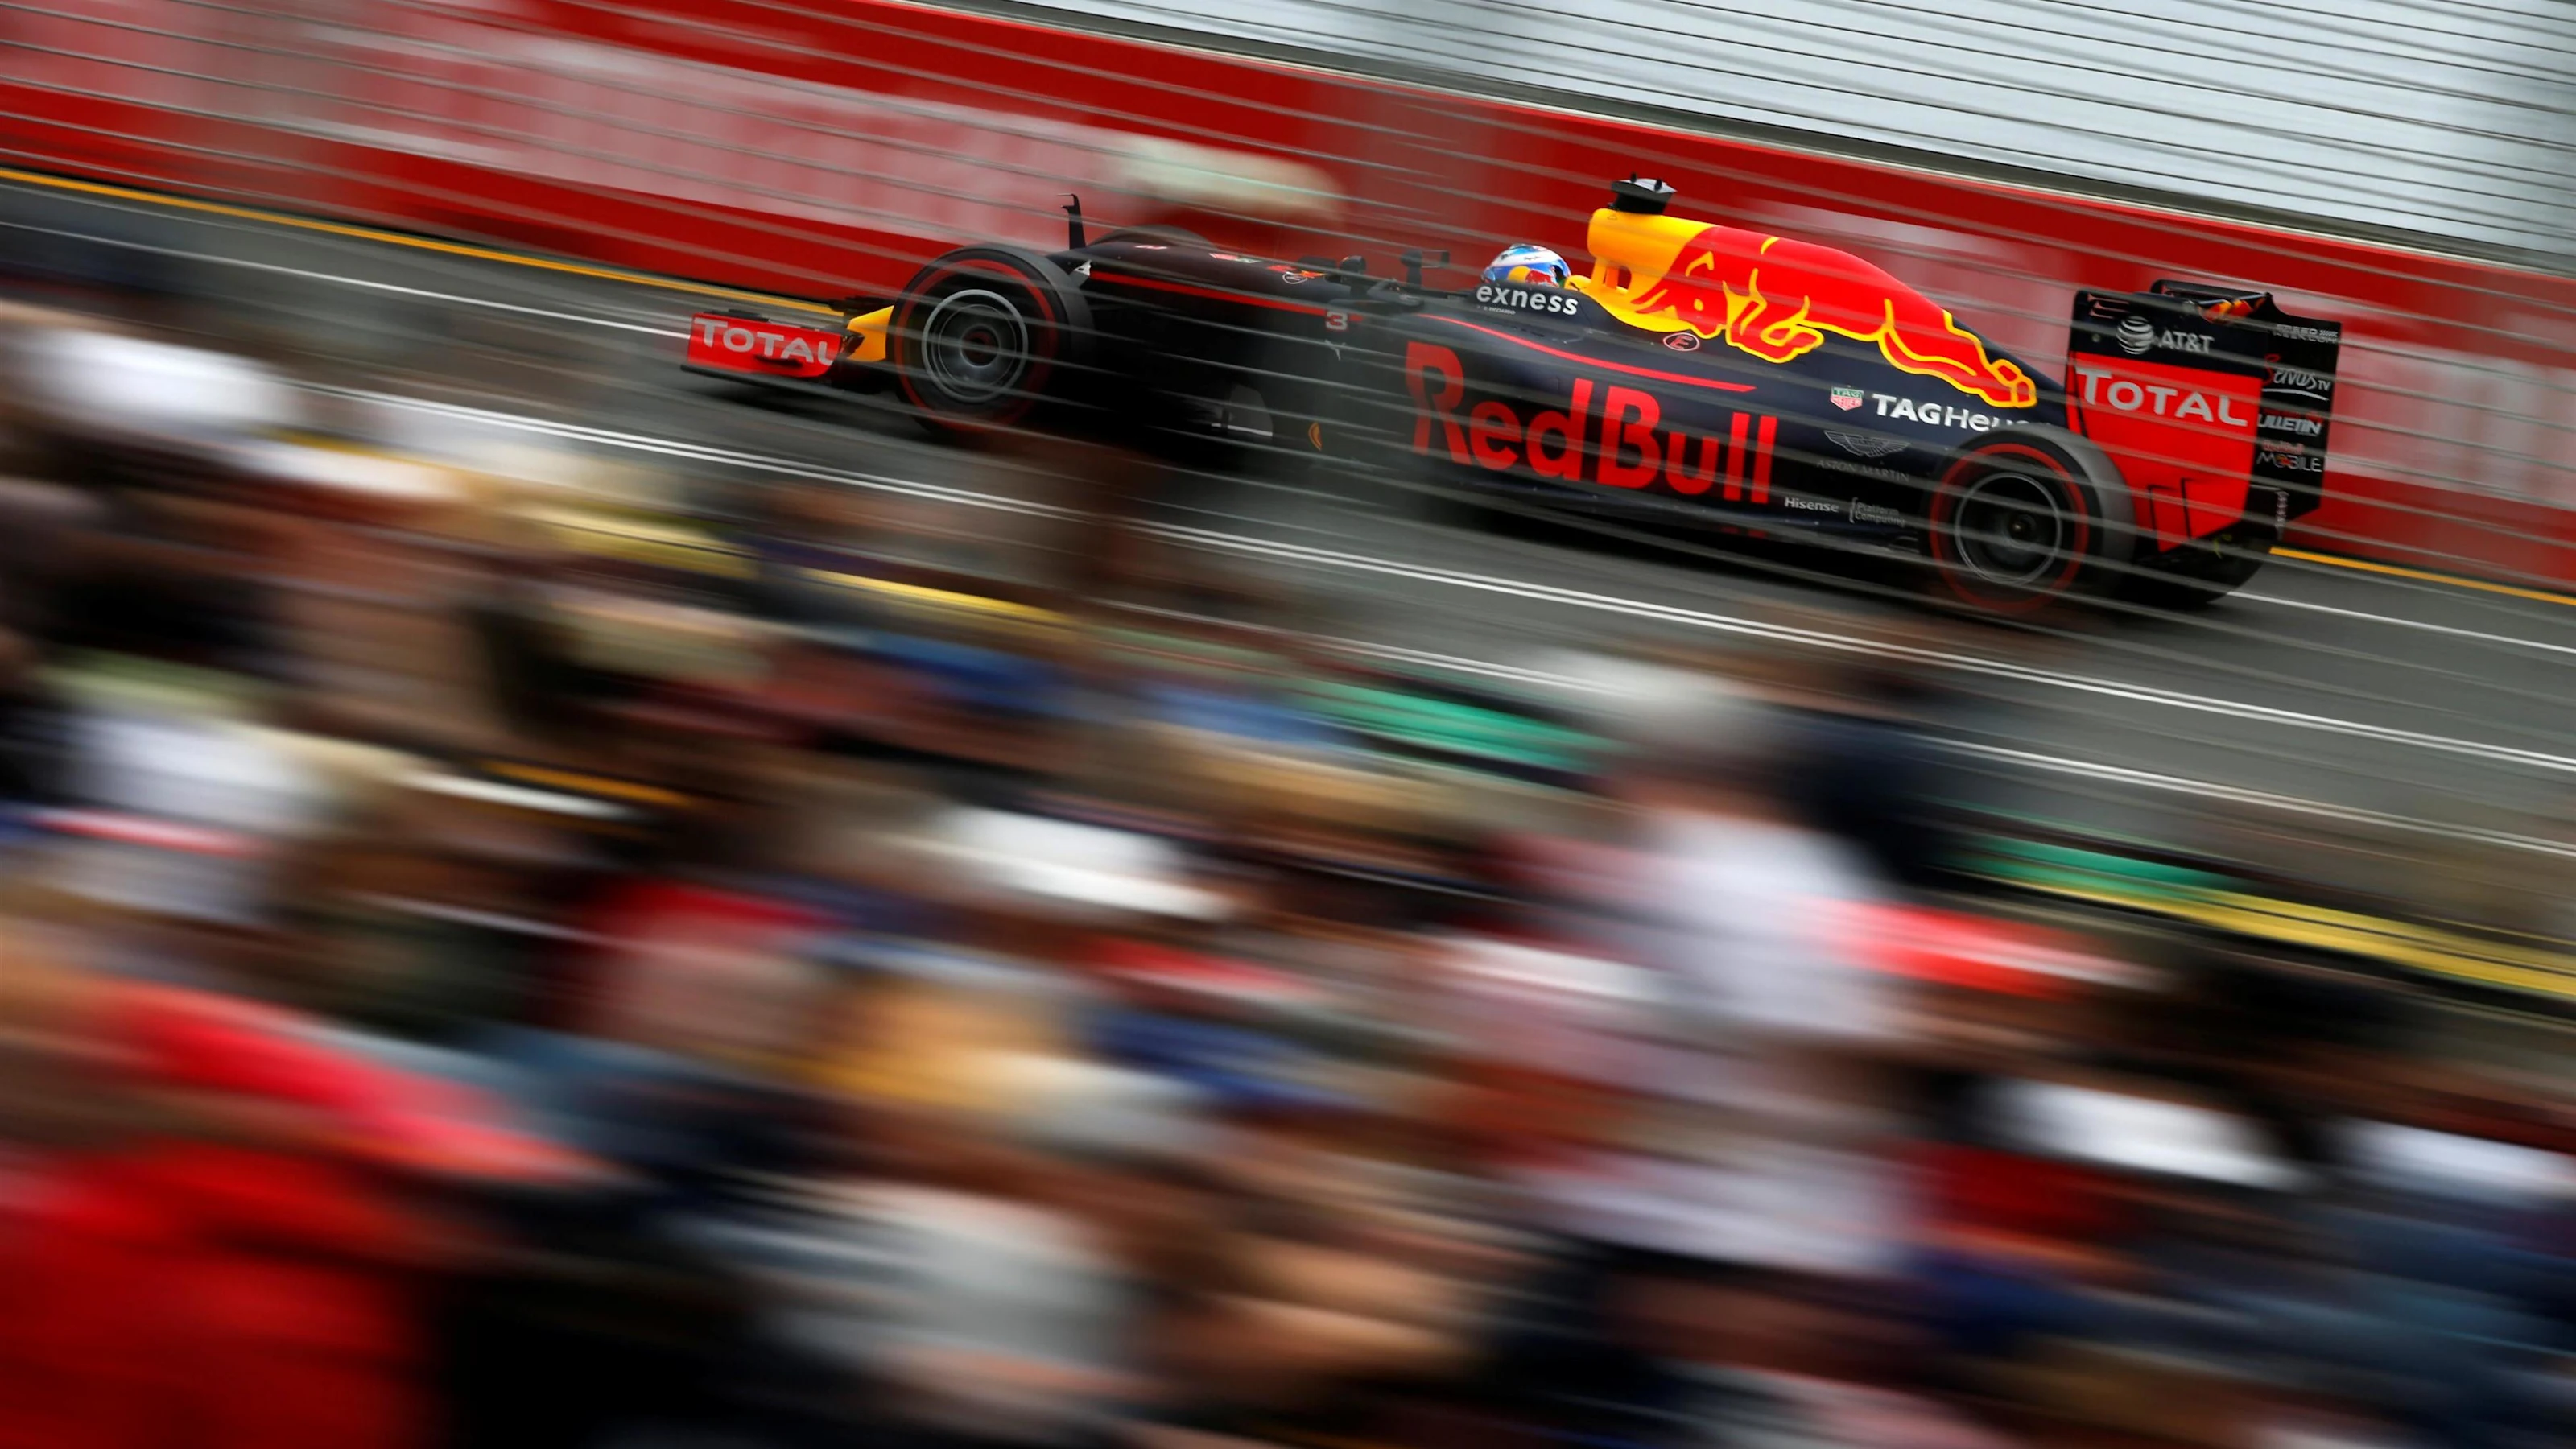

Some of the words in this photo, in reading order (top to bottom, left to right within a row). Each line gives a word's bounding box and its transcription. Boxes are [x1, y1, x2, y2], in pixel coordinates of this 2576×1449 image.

[1476, 285, 1579, 316] exness
[1326, 311, 1348, 330] 3
[694, 317, 834, 367] TOTAL
[2160, 330, 2215, 354] AT&T
[2074, 365, 2248, 427] TOTAL
[1784, 497, 1840, 514] Hisense
